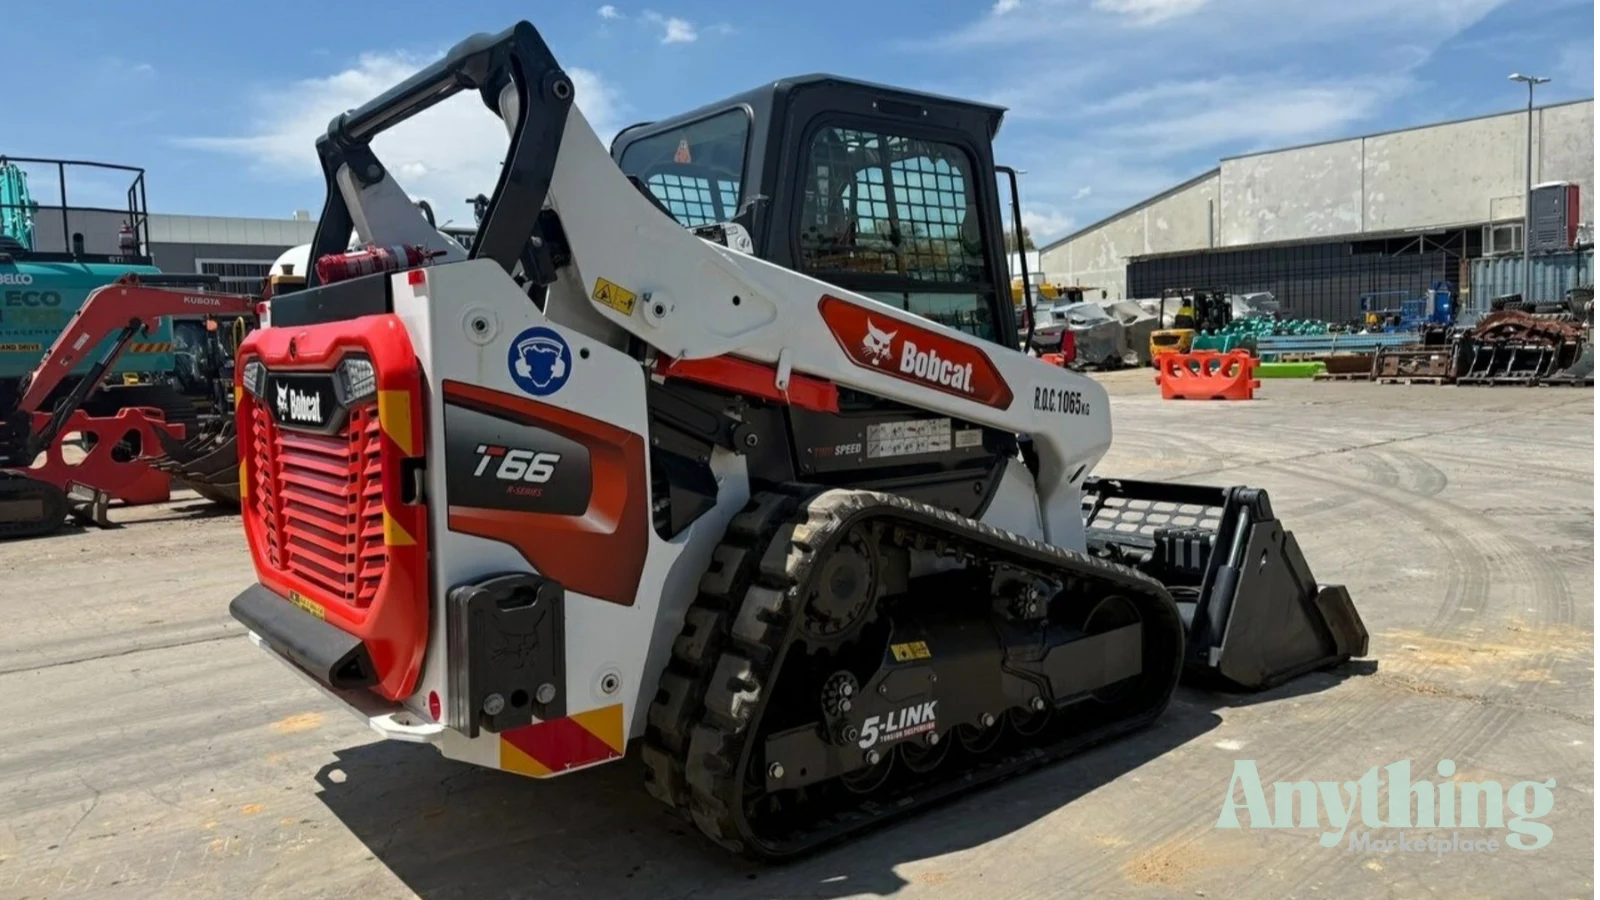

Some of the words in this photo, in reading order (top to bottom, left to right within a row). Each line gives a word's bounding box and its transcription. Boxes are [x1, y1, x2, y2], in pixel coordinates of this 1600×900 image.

[5, 290, 62, 307] ECO
[183, 296, 221, 305] KUBOTA
[899, 340, 974, 393] Bobcat
[289, 388, 321, 423] Bobcat
[473, 444, 561, 484] T66
[834, 443, 862, 456] SPEED
[858, 700, 938, 749] 5-LINK
